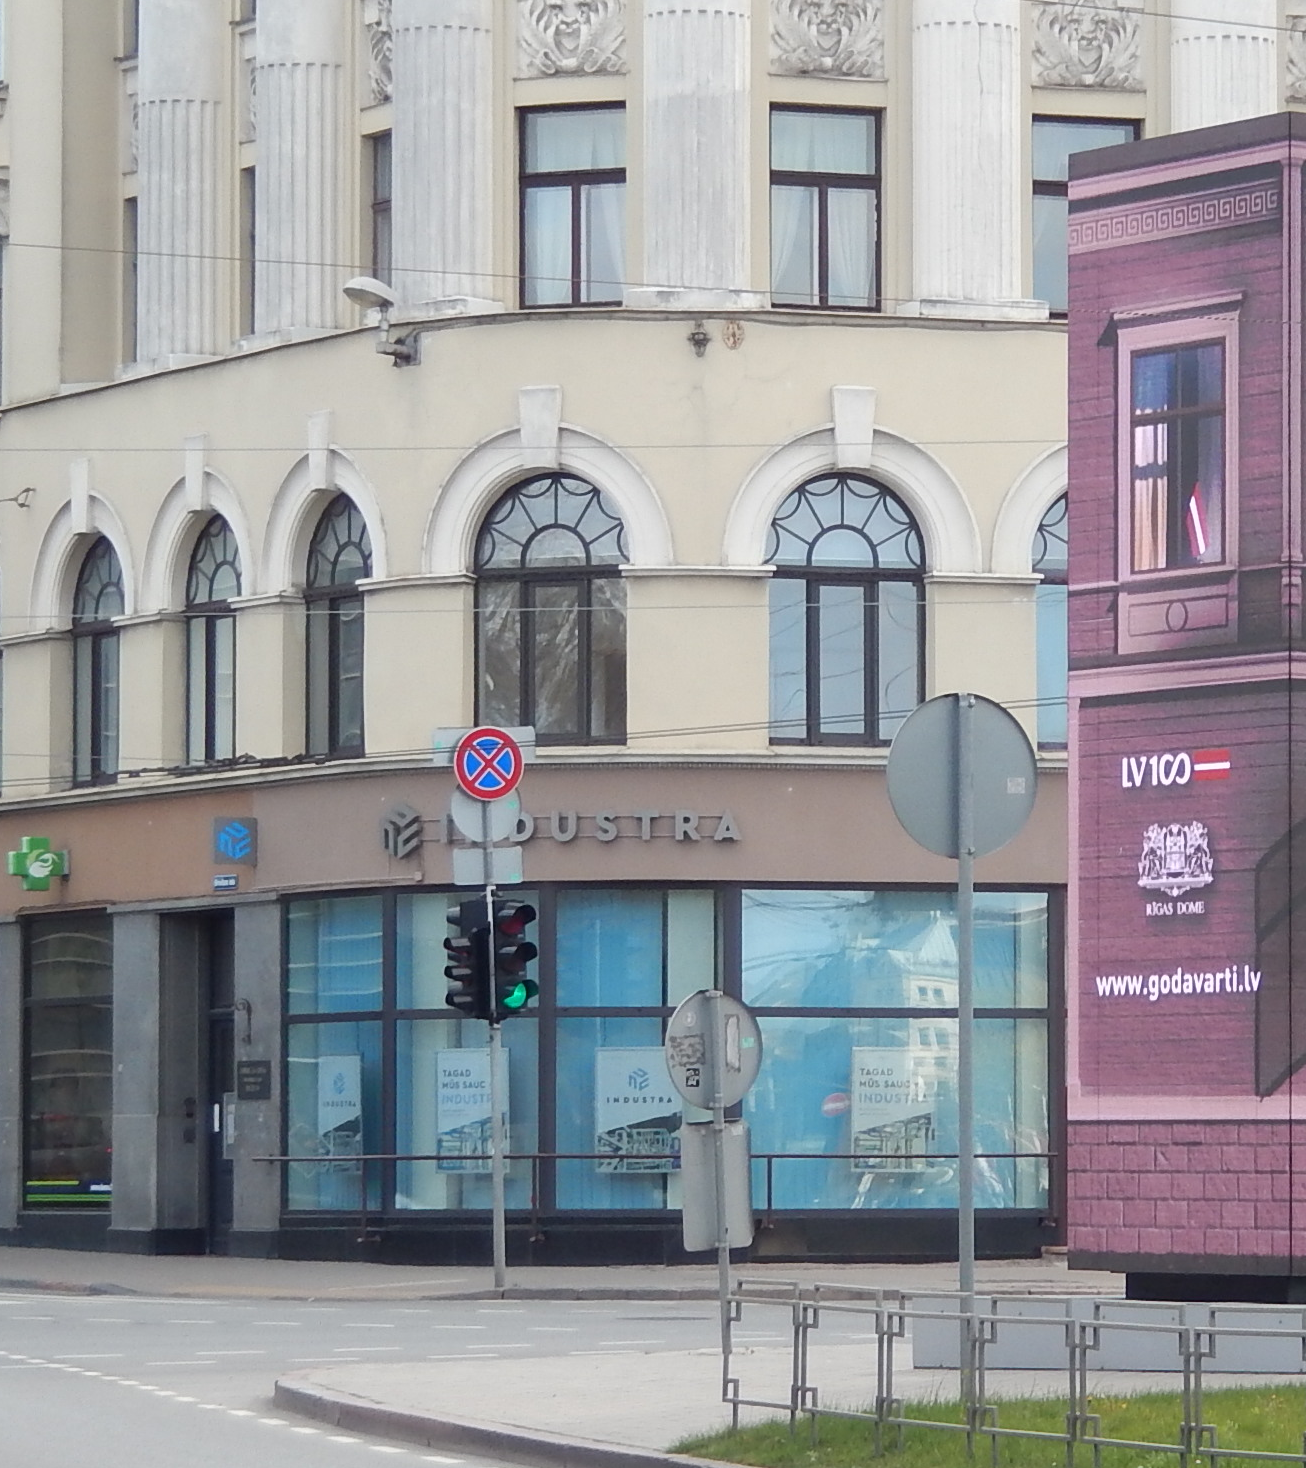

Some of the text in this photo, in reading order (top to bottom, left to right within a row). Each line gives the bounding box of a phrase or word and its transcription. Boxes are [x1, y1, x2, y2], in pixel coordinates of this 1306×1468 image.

[439, 811, 742, 843] IDUSTRA
[1146, 901, 1205, 916] RĪGAS DOME
[1096, 965, 1261, 1001] www.godavarti.lv
[443, 1069, 471, 1078] TAGAD
[859, 1068, 893, 1076] TAGAD
[463, 1080, 486, 1089] SAUC
